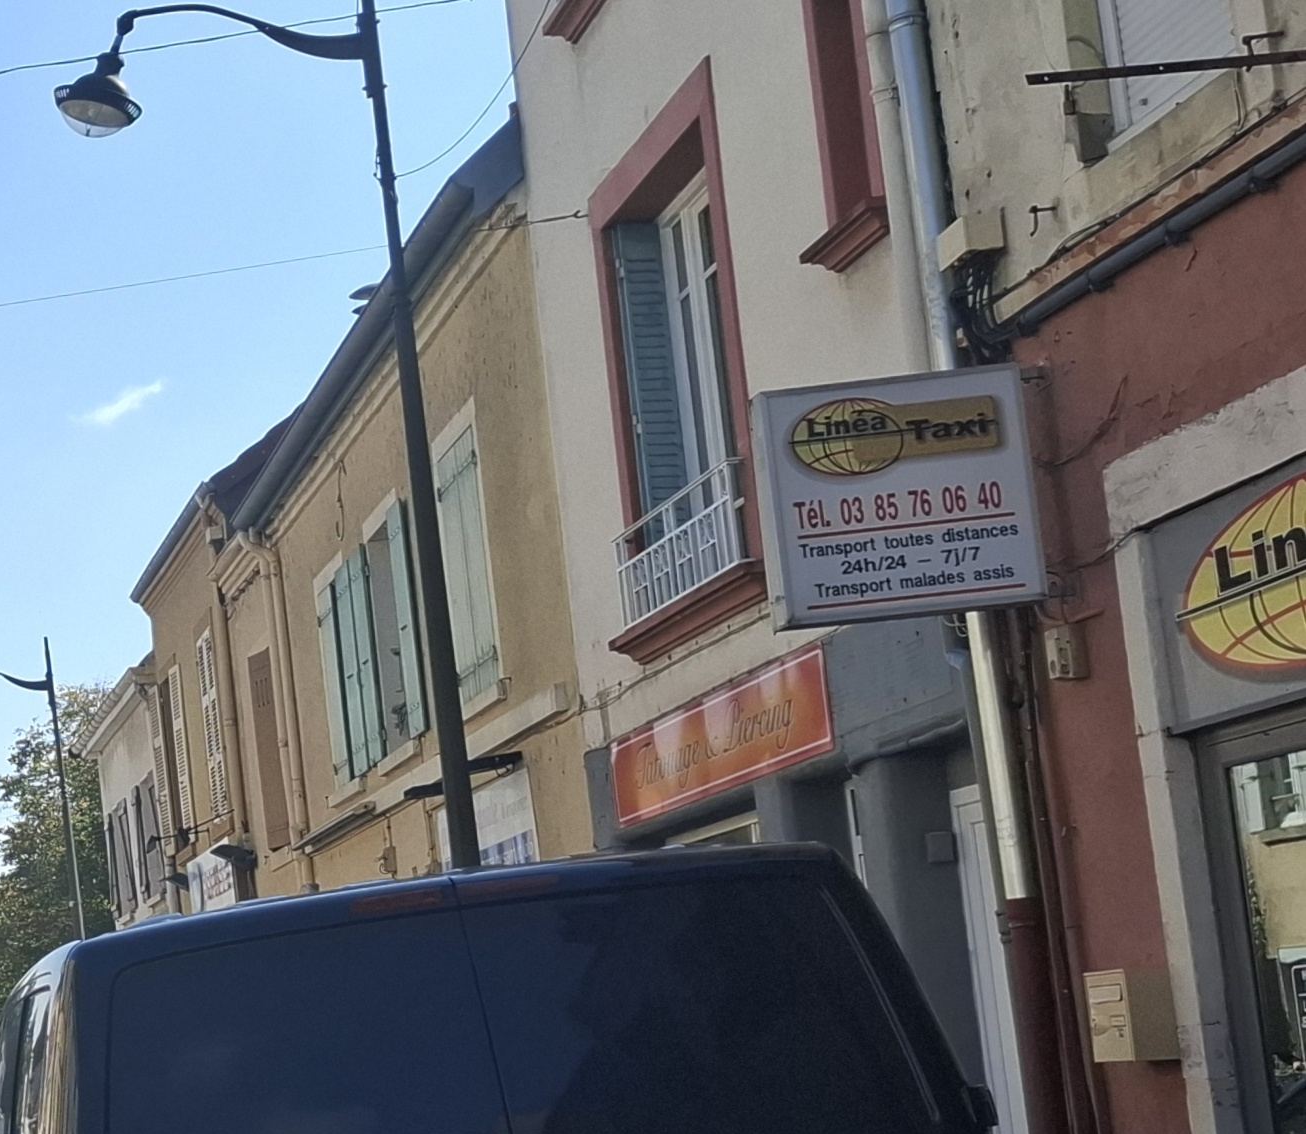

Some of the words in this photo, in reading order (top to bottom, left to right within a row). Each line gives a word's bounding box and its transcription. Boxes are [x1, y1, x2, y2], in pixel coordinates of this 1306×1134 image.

[905, 411, 991, 441] Taxi
[792, 499, 831, 530] Tél.
[840, 496, 865, 526] 03
[874, 492, 899, 522] 85
[907, 488, 933, 517] 76
[941, 485, 967, 514] 06
[977, 481, 1002, 510] 40
[798, 536, 877, 559] Transport
[884, 531, 934, 550] toutes
[941, 523, 1019, 544] distances
[840, 554, 908, 575] 24h/24
[940, 546, 981, 567] 7j/7
[814, 577, 892, 599] Transport
[899, 570, 966, 590] malades
[973, 563, 1015, 581] assis
[724, 698, 794, 750] Piercing
